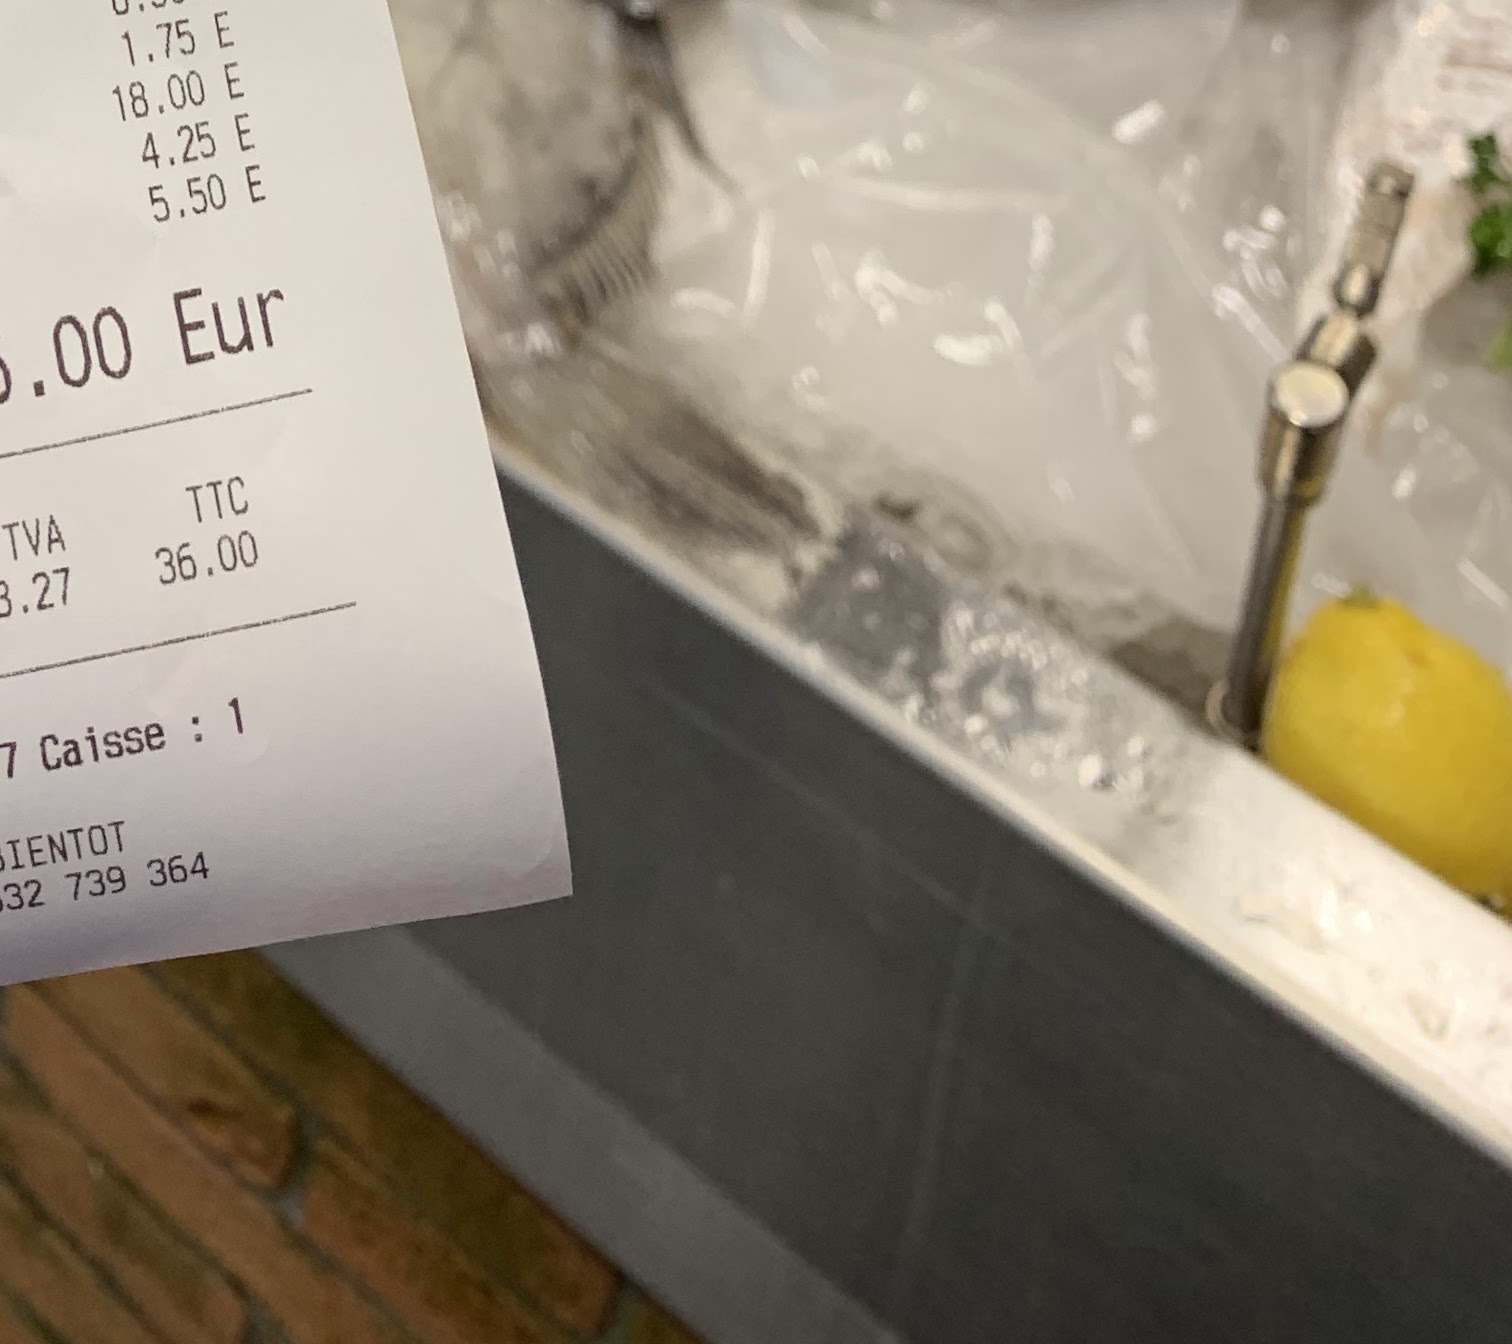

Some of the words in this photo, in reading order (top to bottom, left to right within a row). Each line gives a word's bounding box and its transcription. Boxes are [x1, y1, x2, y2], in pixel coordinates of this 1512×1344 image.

[121, 17, 196, 67] 1.75
[213, 10, 235, 49] E
[111, 69, 206, 122] 18.00
[223, 61, 245, 101] E
[141, 120, 217, 170] 4.25
[233, 112, 256, 153] E
[147, 172, 227, 224] 5.50
[244, 163, 267, 204] E
[172, 287, 285, 366] Eur
[0, 514, 67, 562] TVA
[184, 475, 249, 524] TTC
[154, 529, 259, 586] 36.00
[39, 722, 167, 772] Caisse
[227, 696, 244, 735] 1
[64, 865, 127, 901] 739
[146, 851, 210, 887] 364
